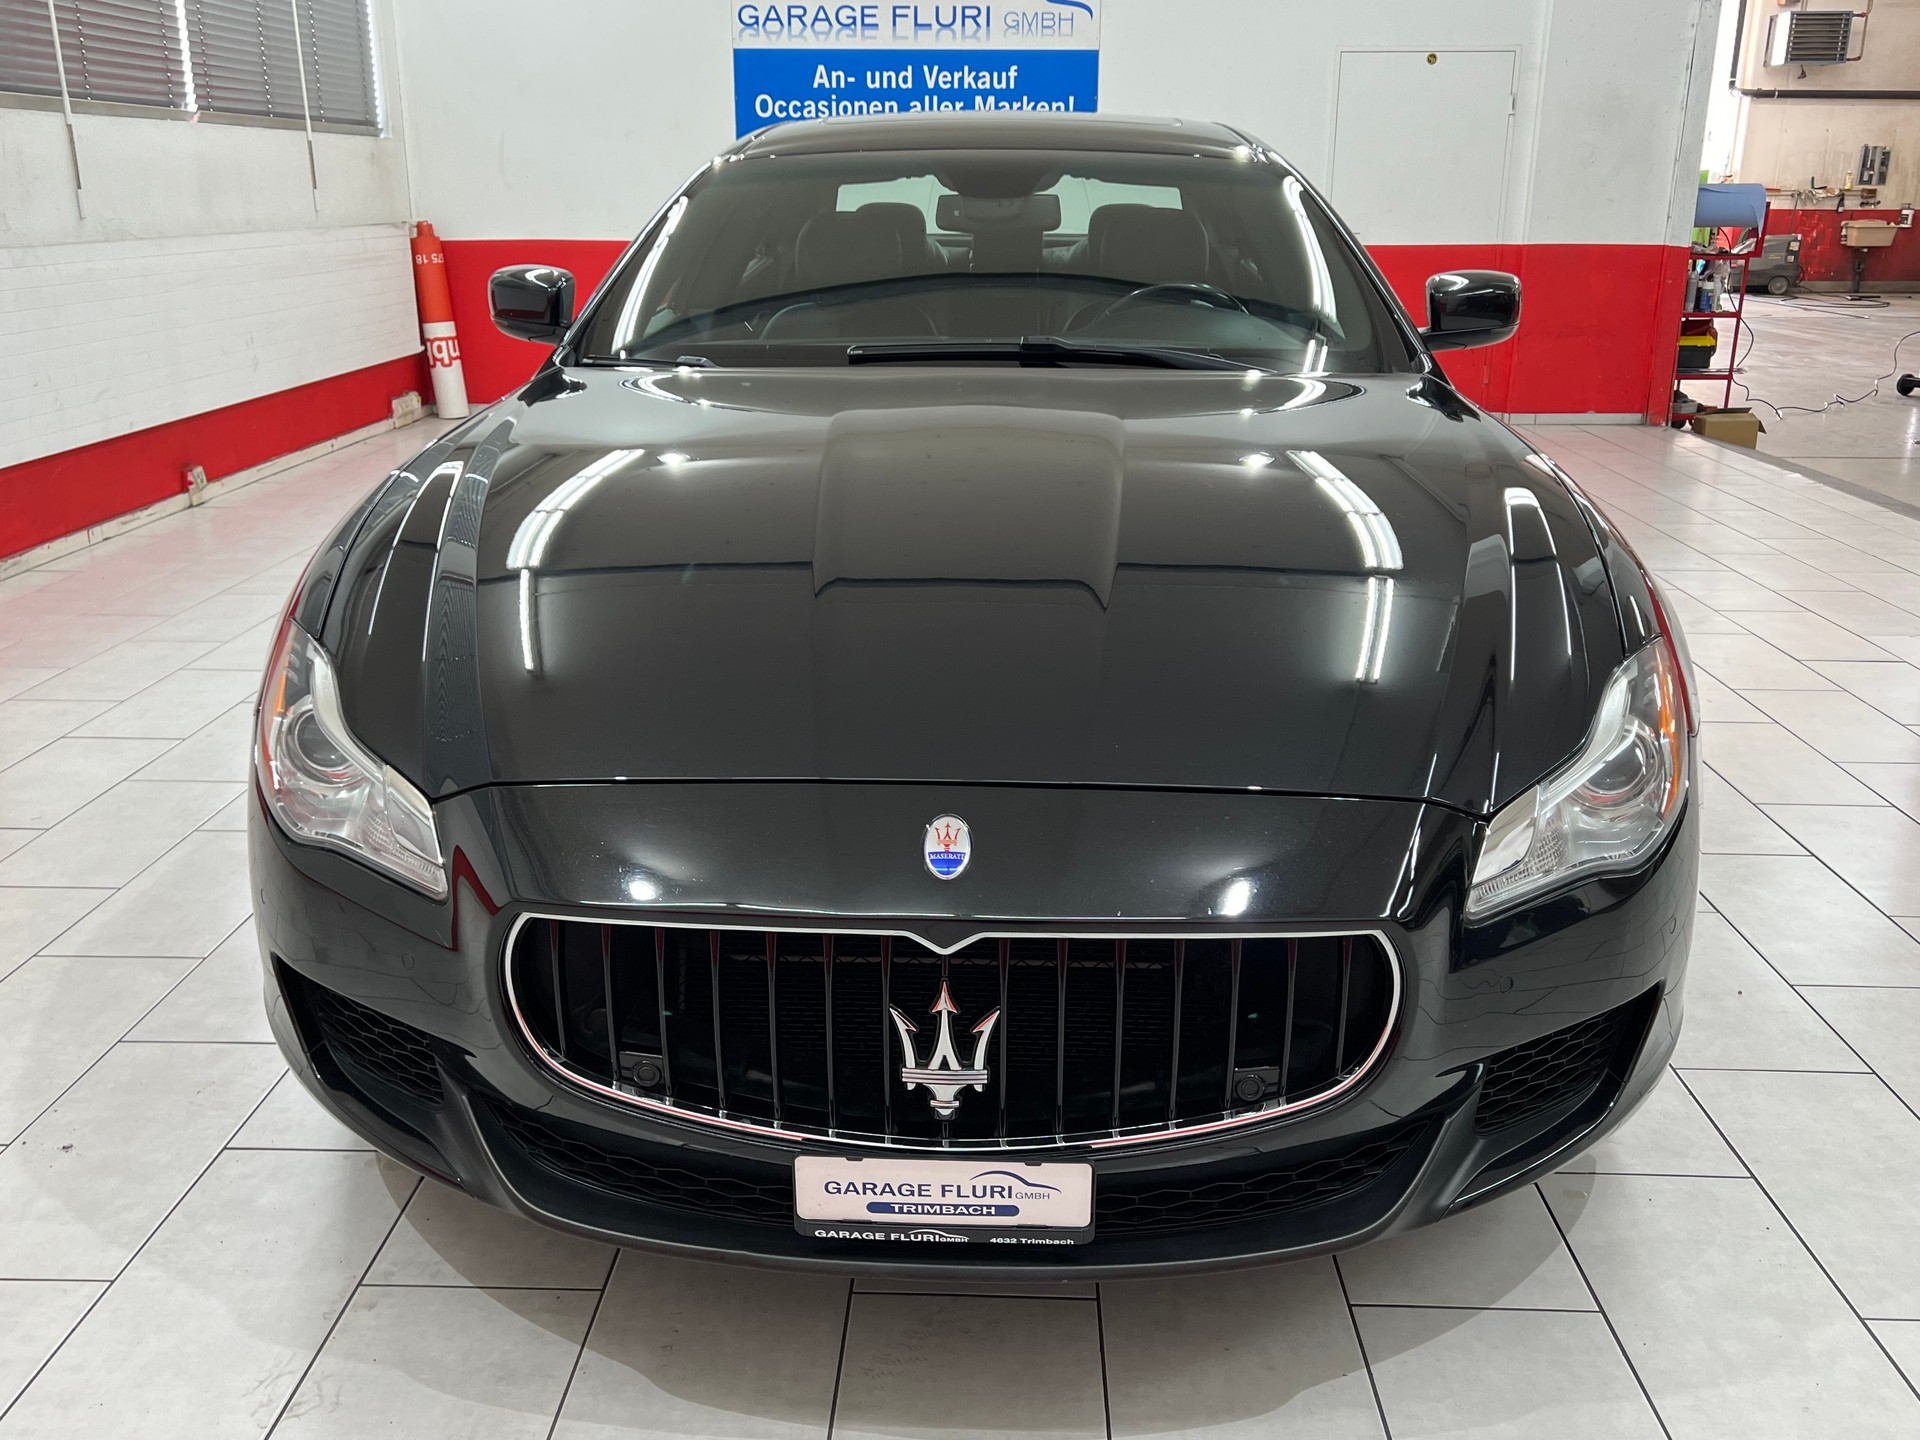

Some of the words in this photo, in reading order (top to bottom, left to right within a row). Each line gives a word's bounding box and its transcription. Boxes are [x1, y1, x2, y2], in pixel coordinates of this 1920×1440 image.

[737, 4, 880, 29] GARAGE
[891, 5, 991, 29] FLURI
[1003, 11, 1074, 29] GMBH
[812, 64, 856, 89] An-
[866, 65, 913, 89] und
[922, 65, 1018, 90] Verkauf
[754, 94, 899, 118] Occasionen
[823, 1181, 933, 1198] GARAGE
[941, 1185, 1014, 1199] FLURI
[1015, 1192, 1051, 1200] GMBH
[890, 1204, 997, 1216] TRIMBACH
[814, 1230, 886, 1241] GARAGE
[890, 1233, 939, 1243] FLURI
[1020, 1238, 1075, 1246] Trimbach
